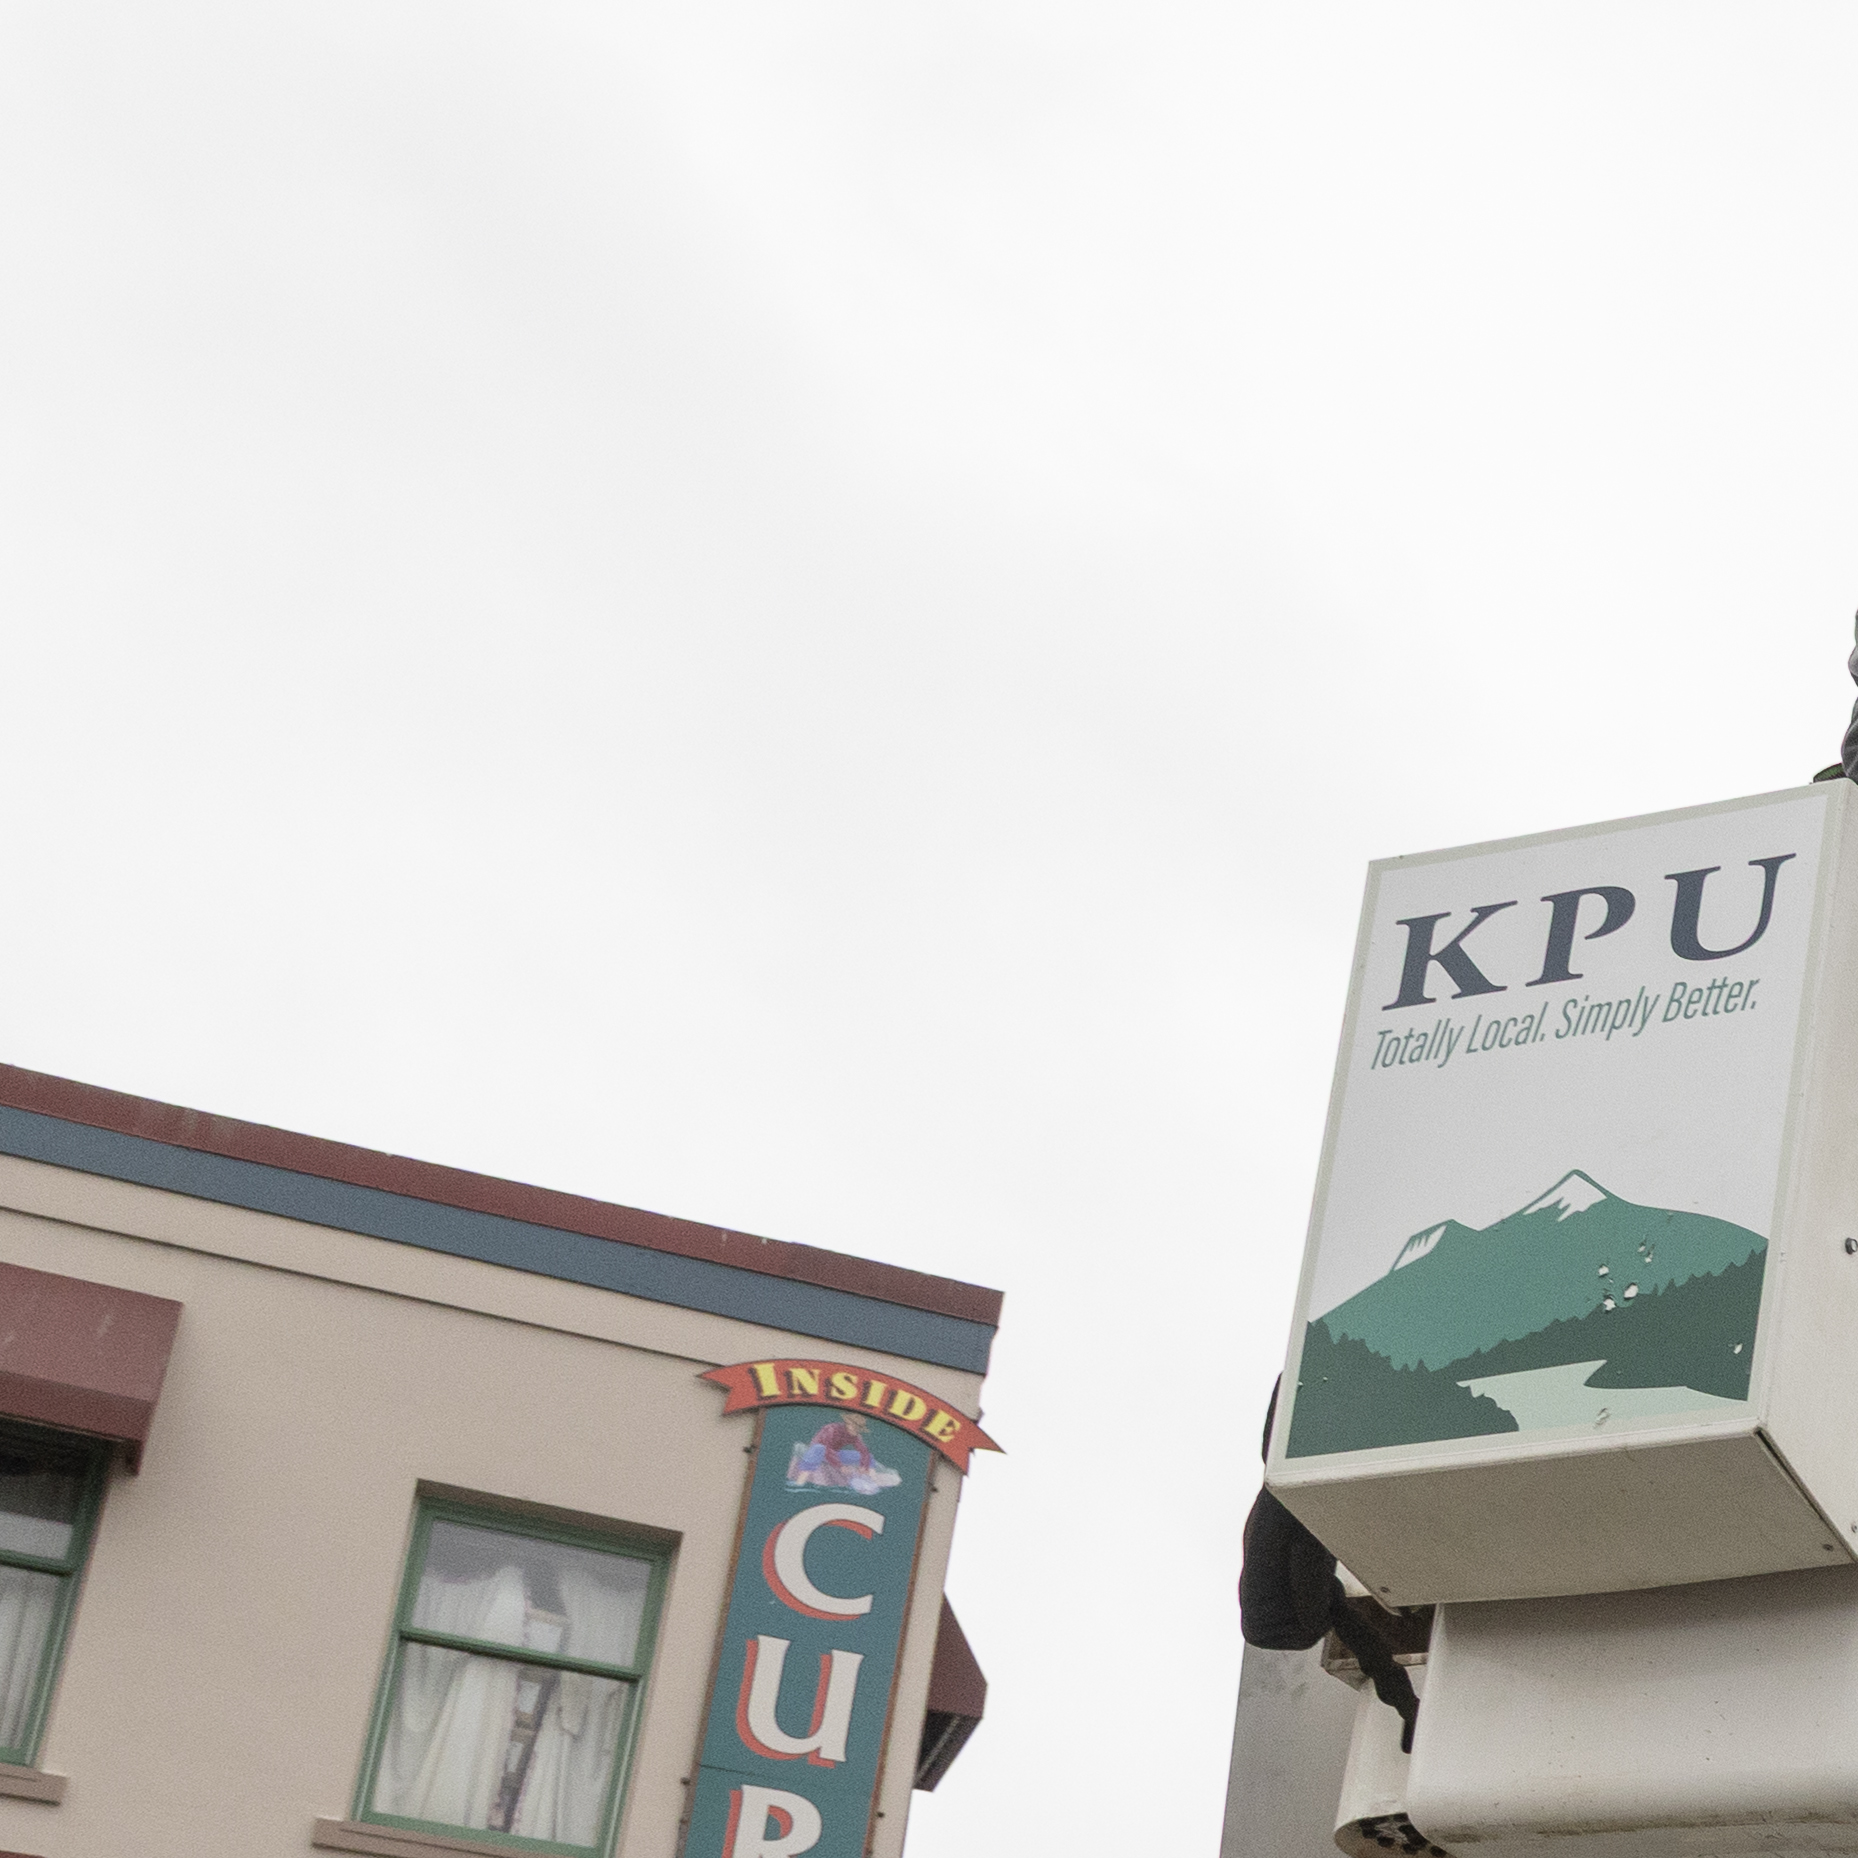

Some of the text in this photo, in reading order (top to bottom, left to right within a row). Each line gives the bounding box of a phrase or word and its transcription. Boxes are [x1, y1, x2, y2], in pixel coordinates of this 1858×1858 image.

[1381, 852, 1797, 1011] KPU
[1370, 976, 1760, 1070] Totally Local. Simply Better.
[748, 1362, 961, 1443] INSIDE
